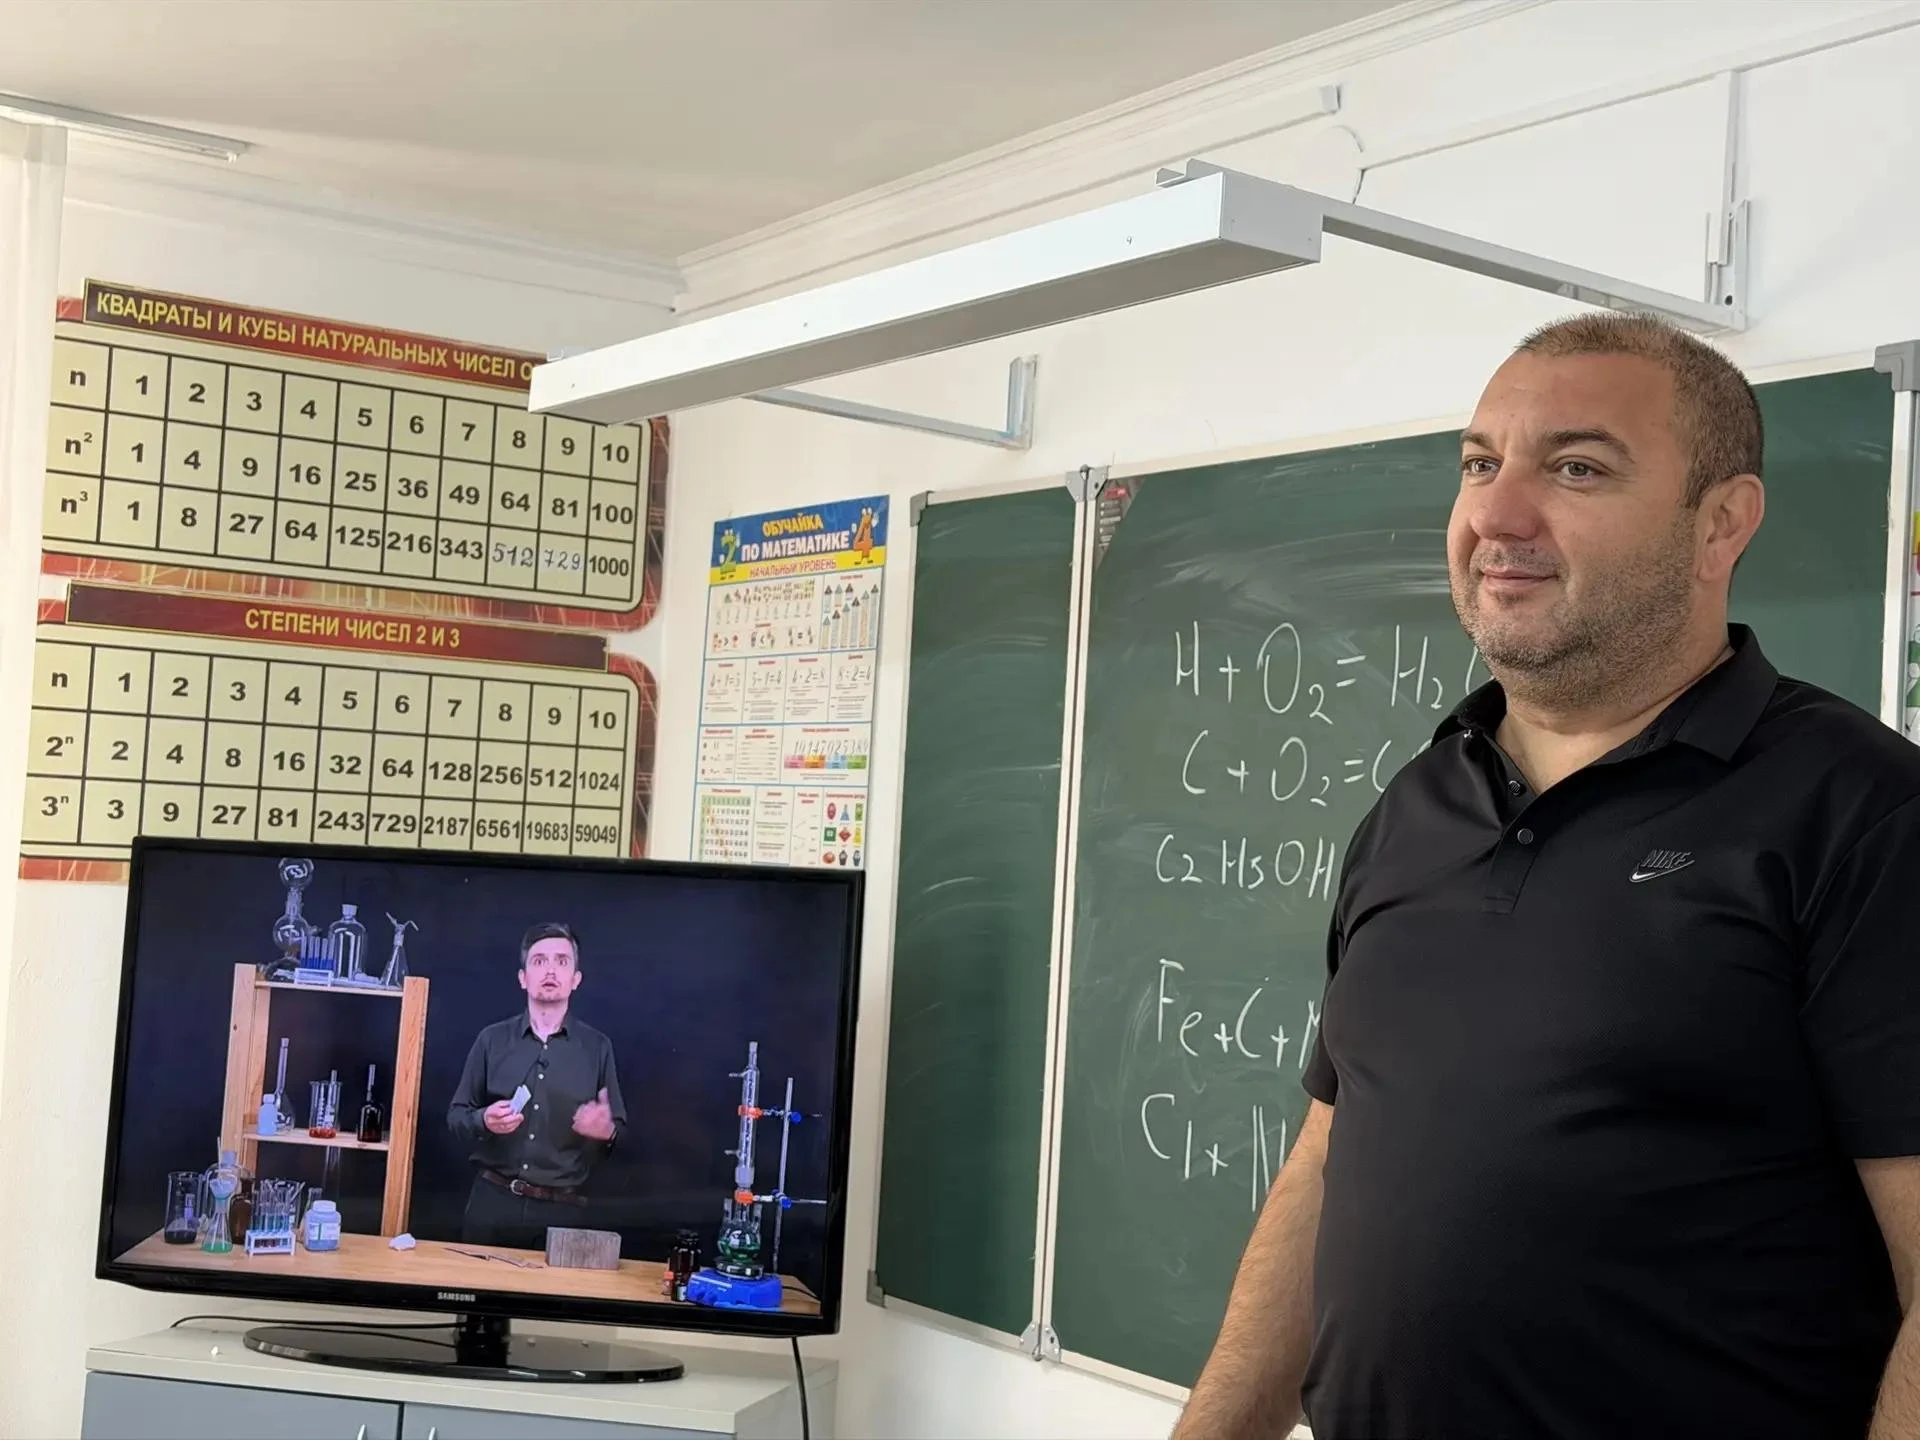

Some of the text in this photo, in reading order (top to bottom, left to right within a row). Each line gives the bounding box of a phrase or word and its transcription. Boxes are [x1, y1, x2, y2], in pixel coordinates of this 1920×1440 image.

[97, 293, 212, 331] КВАДРАТЫ
[218, 313, 233, 335] И
[238, 318, 297, 344] КУБЫ
[302, 327, 448, 368] НАТУРАЛЬНЫХ
[453, 350, 516, 379] ЧИСЕЛ
[70, 371, 630, 464] n 1 2 3 4 5 6 7 8 9 10
[132, 443, 144, 463] 1
[184, 451, 202, 470] 4
[243, 458, 258, 477] 9
[290, 464, 321, 485] 16
[345, 471, 377, 492] 25
[398, 478, 429, 499] 36
[449, 485, 480, 505] 49
[501, 492, 531, 512] 64
[552, 498, 578, 518] 81
[592, 504, 634, 525] 100
[128, 501, 140, 521] 1
[181, 508, 197, 528] 8
[230, 514, 264, 535] 27
[285, 520, 318, 541] 64
[336, 526, 381, 548] 125
[387, 532, 433, 554] 216
[440, 538, 483, 560] 343
[493, 543, 534, 568] 512
[545, 551, 581, 570] 729
[590, 556, 630, 577] 1000
[741, 531, 850, 562] ПО МАТЕМАТИКЕ
[762, 513, 824, 537] ОБУЧАЙКА
[750, 559, 837, 578] НАЧАЛЬНЫЙ УРОВЕНЬ
[245, 608, 460, 648] СТЕПЕНИ ЧИСЕЛ 2 И 3
[52, 673, 617, 730] n 1 2 3 4 5 6 7 8 9 10
[112, 741, 129, 761] 2
[167, 745, 184, 764] 4
[226, 748, 242, 768] 8
[274, 752, 306, 772] 16
[330, 755, 362, 775] 32
[383, 759, 414, 779] 64
[429, 762, 472, 782] 128
[480, 765, 523, 786] 256
[530, 768, 572, 789] 512
[580, 772, 620, 791] 1024
[108, 800, 124, 820] 3
[164, 803, 180, 823] 9
[212, 805, 247, 825] 27
[268, 808, 298, 828] 81
[318, 811, 365, 832] 243
[372, 814, 417, 834] 729
[424, 816, 469, 836] 2187
[476, 819, 521, 839] 6561
[527, 822, 569, 842] 19683
[576, 824, 617, 844] 59049
[1640, 849, 1692, 869] NIKE
[437, 1291, 476, 1302] SAMSUNG
